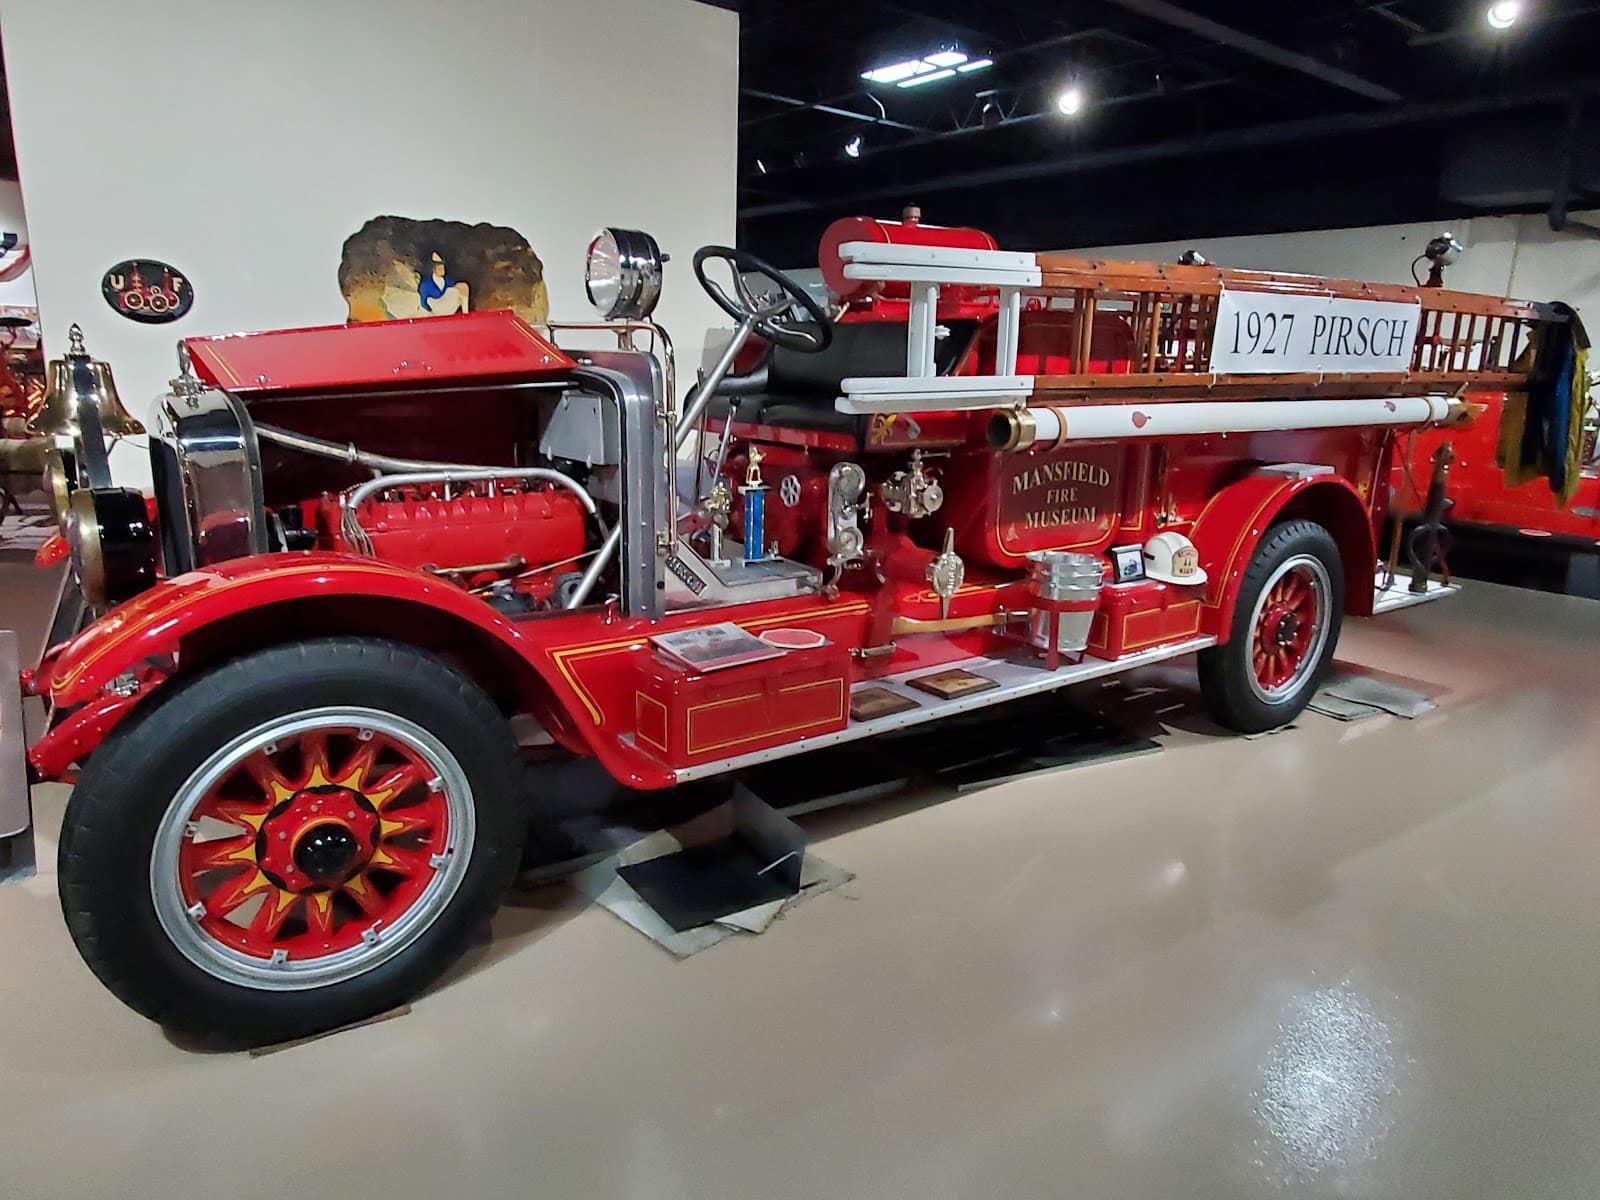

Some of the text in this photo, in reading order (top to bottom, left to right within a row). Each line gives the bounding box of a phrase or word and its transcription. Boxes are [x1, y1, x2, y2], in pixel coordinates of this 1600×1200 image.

[109, 274, 183, 292] U F
[1230, 311, 1409, 356] 1927 PIRSCH
[1012, 461, 1110, 495] MANSFIELD
[1047, 487, 1079, 504] FIRE
[1025, 506, 1096, 529] MUSEUM
